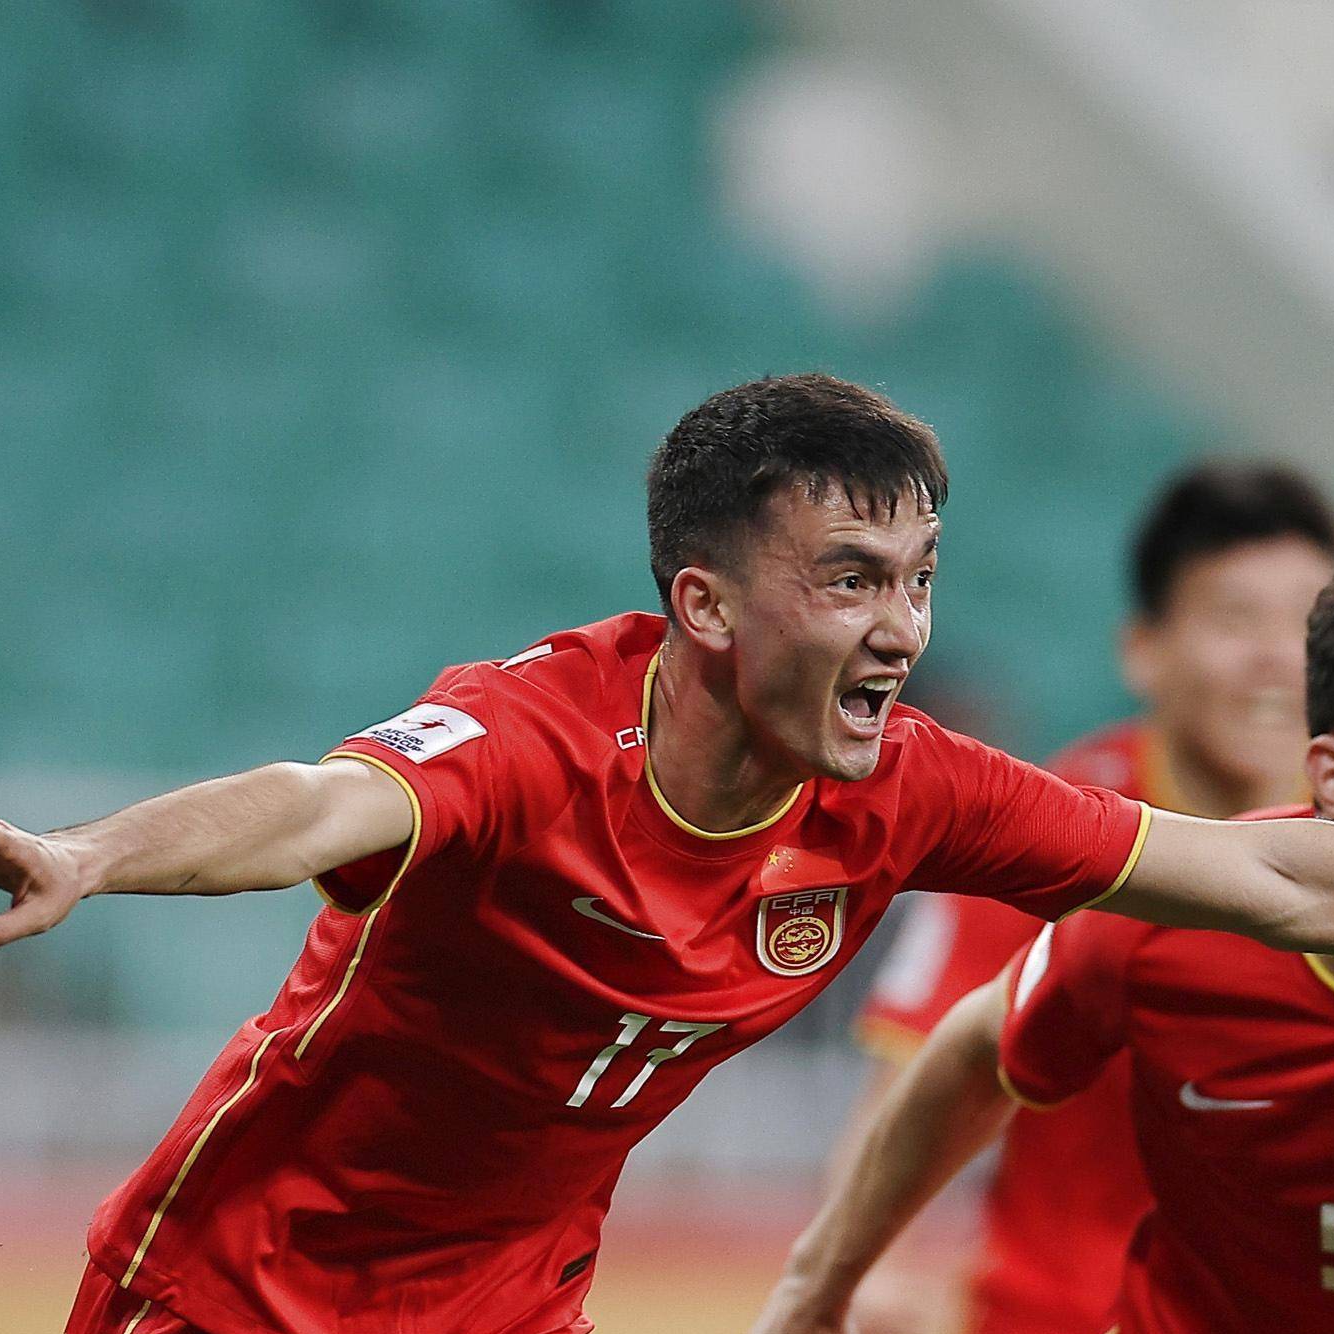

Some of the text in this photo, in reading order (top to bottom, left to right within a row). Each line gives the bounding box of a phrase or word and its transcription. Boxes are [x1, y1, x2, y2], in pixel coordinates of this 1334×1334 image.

[616, 726, 645, 750] CF
[771, 892, 835, 910] CFA
[565, 1012, 728, 1108] 17
